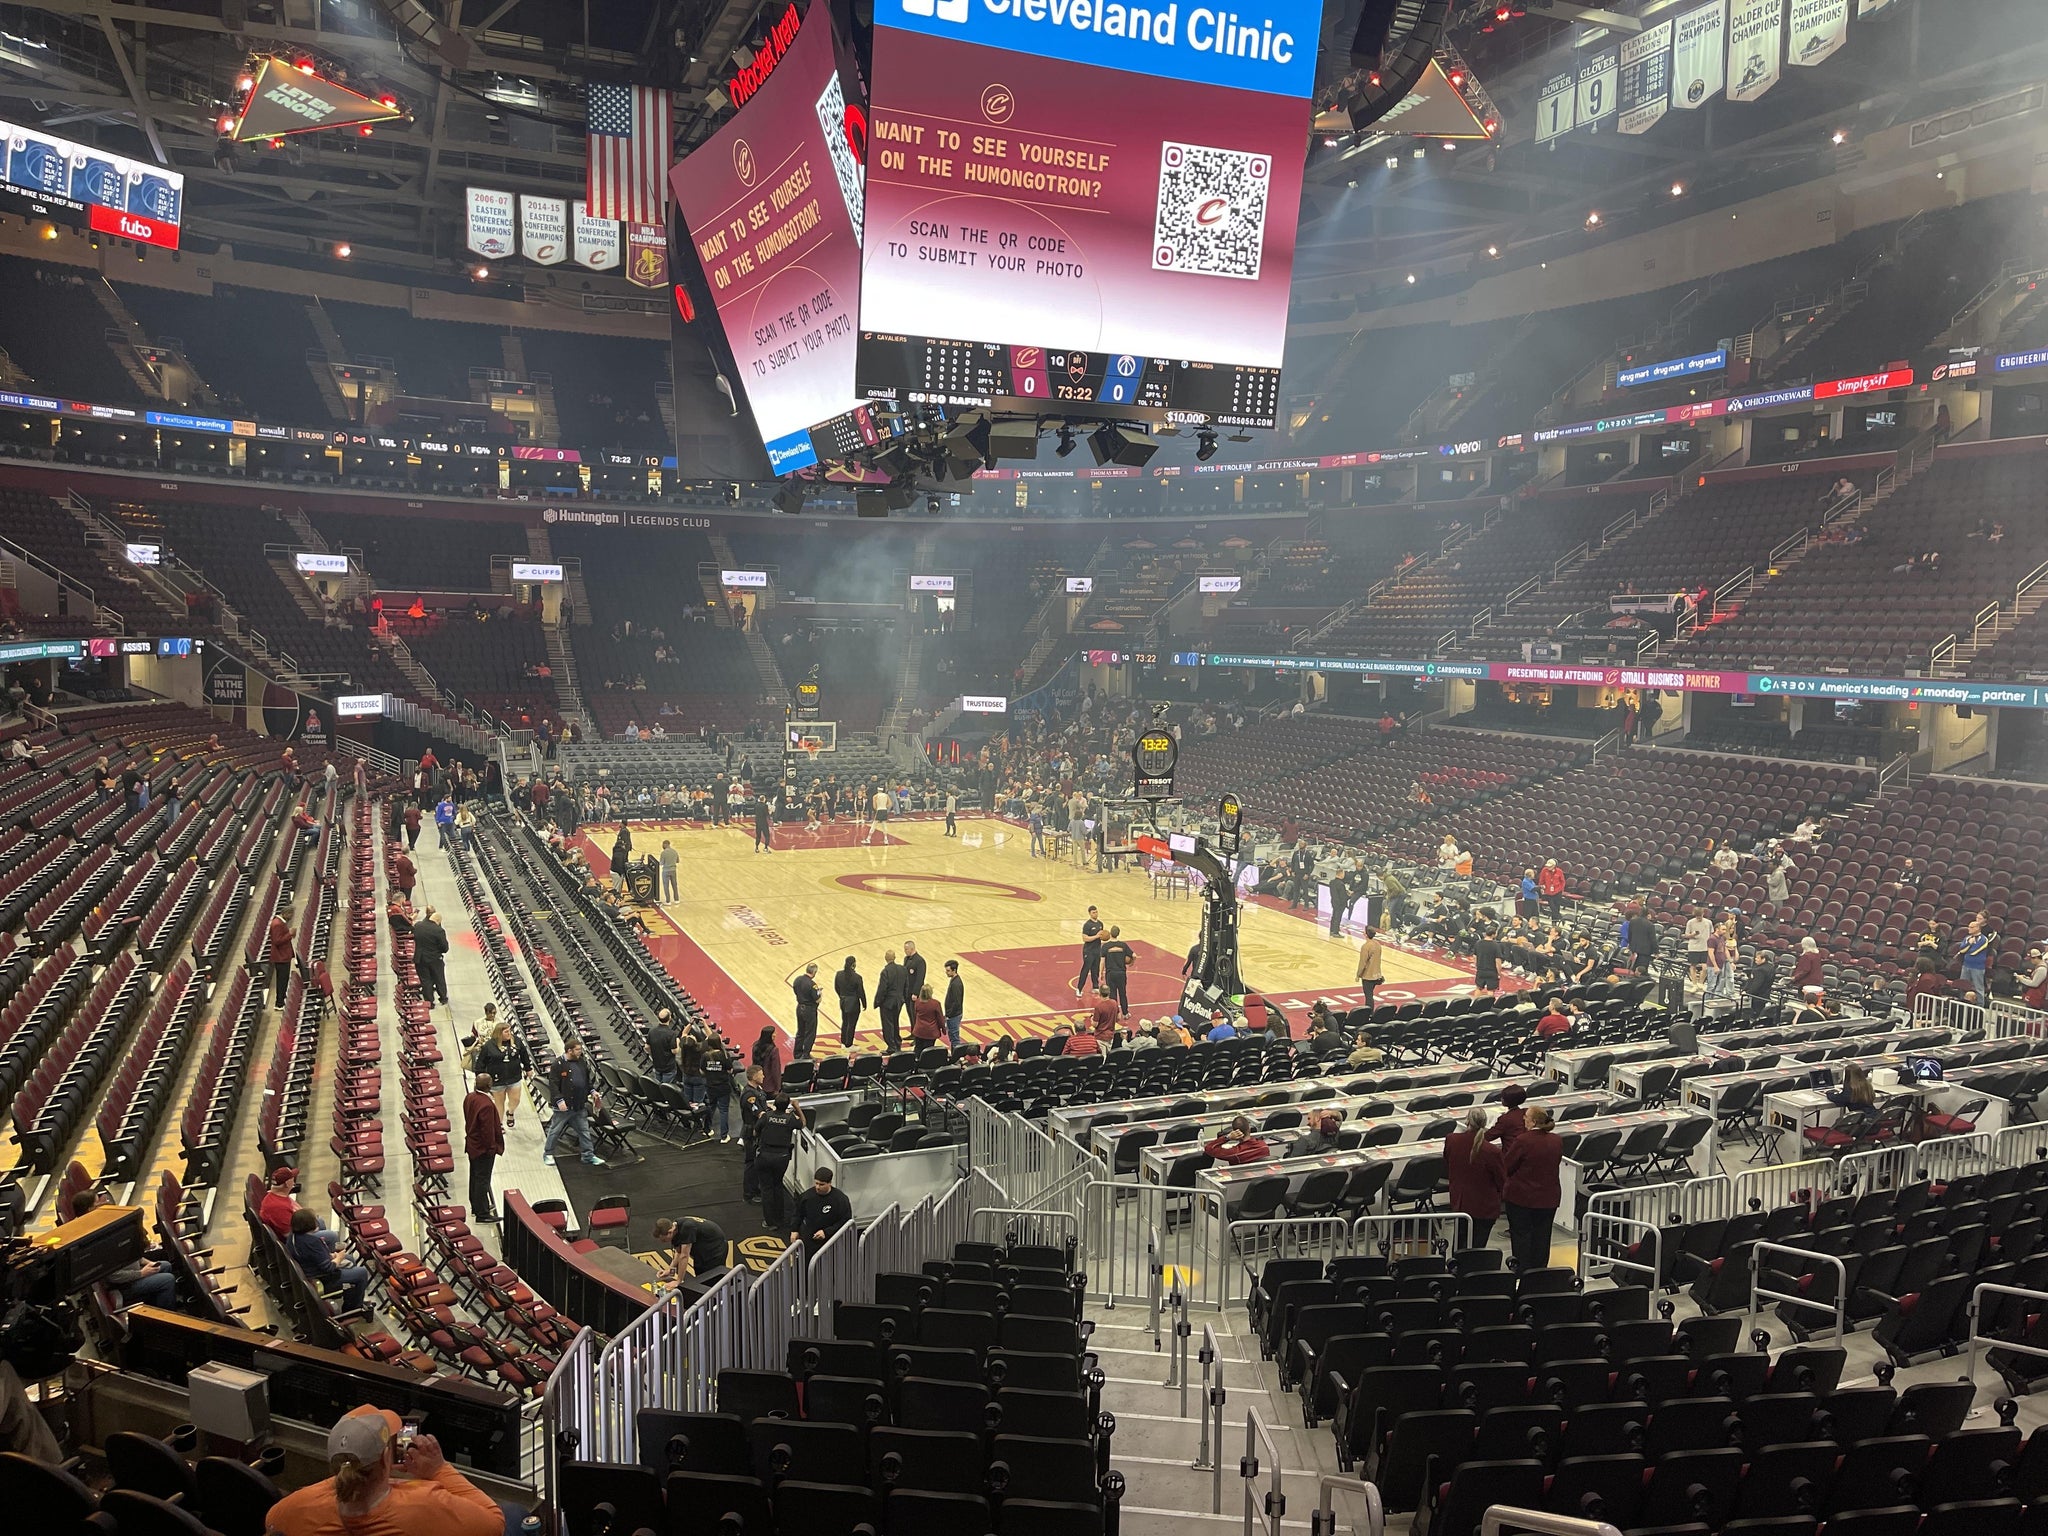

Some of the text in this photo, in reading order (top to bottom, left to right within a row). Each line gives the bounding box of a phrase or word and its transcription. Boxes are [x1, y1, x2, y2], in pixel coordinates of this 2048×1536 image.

[1732, 0, 1781, 30] CALDER CUP
[1794, 6, 1843, 34] CHAMPIONS
[1678, 16, 1721, 44] CHAMPIONS
[1732, 14, 1780, 44] CHAMPIONS
[1187, 8, 1295, 64] Clinic
[1622, 25, 1670, 53] CLEVELAND
[738, 2, 801, 100] Rocket Arena
[1629, 39, 1662, 59] BARONS
[1580, 55, 1616, 78] GLOVER
[1542, 77, 1571, 96] BOWER
[1590, 79, 1603, 115] 9
[264, 90, 326, 122] KNOW.
[1550, 97, 1559, 133] 1
[875, 119, 1110, 172] WANT TO SEE YOURSELF
[880, 149, 1102, 198] ON THE HUMONGOTRON?
[6, 184, 84, 211] REF MIKE MIKE
[474, 193, 508, 205] 2006-07
[476, 206, 507, 216] EASTERN
[528, 201, 560, 212] 2014-15
[699, 161, 812, 262] WANT TO SEE YOURSELF
[471, 215, 513, 227] CONFERENCE
[529, 213, 559, 222] EASTERN
[582, 217, 611, 228] EASTERN
[120, 217, 152, 238] fubo
[472, 224, 511, 236] CHAMPIONS
[524, 221, 565, 233] CONFERENCE
[576, 228, 617, 238] CONFERENCE
[641, 226, 655, 236] NBA
[526, 230, 563, 242] CHAMPIONS
[578, 236, 615, 247] CHAMPIONS
[630, 233, 667, 246] CHAMPIONS
[909, 220, 1066, 253] SCAN THE QR CODE
[714, 198, 822, 289] ON THE HUMONGOTRON?
[888, 242, 1084, 278] TO SUBMIT YOUR PHOTO
[754, 289, 833, 346] SCAN THE QR CODE
[752, 313, 850, 377] TO SUBMIT YOUR PHOTO
[876, 335, 908, 343] CAVALIERS
[1050, 355, 1065, 367] 1Q
[1620, 355, 1721, 382] drug mart drug mart drug mart
[1948, 366, 1976, 378] PARTNERS
[1024, 377, 1035, 394] 0
[867, 388, 897, 398] oswald
[1057, 385, 1093, 401] 73:22
[1113, 384, 1124, 401] 0
[1744, 388, 1811, 407] OHIO STONEWARE
[948, 395, 992, 407] RAFFLE
[163, 415, 194, 426] textbook
[196, 420, 226, 430] painting
[1166, 412, 1205, 424] $10,000
[1217, 415, 1273, 427] CAVS5050.COM
[259, 427, 285, 437] oswald
[1539, 428, 1559, 440] watr
[379, 438, 491, 456] TOL 7 FOULS FG%
[557, 450, 564, 460] 0
[611, 455, 631, 464] 73:22
[645, 456, 659, 466] 1Q
[1216, 463, 1252, 472] PETROLEUM
[1265, 460, 1302, 469] CITY DESK
[1787, 463, 1799, 472] 107
[559, 509, 711, 528] Huntington LEGENDS CLUB
[316, 559, 346, 567] CLIFFS
[109, 643, 115, 653] 0
[122, 642, 150, 652] ASSISTS
[163, 643, 170, 652] 0
[1111, 652, 1118, 662] 0
[1135, 653, 1157, 663] 73:22
[1174, 654, 1180, 664] 0
[1320, 661, 1327, 669] WE
[1343, 662, 1355, 670] BUILD
[1373, 663, 1395, 671] BUSINESS
[1395, 664, 1425, 672] OPERATIONS
[1437, 666, 1482, 675] CARBONWEB.CO
[1508, 667, 1603, 682] PRESENTING OUR ATTENDING
[1621, 672, 1720, 689] SMALL BUSINESS PARTNER
[214, 680, 243, 689] IN THE
[214, 690, 243, 699] PAINT
[1820, 682, 2026, 703] America's leading partner
[341, 700, 380, 710] TRUSTEDSEC
[1142, 738, 1169, 751] 73:22
[1183, 996, 1213, 1020] KeyBank
[769, 1116, 787, 1125] POLICE
